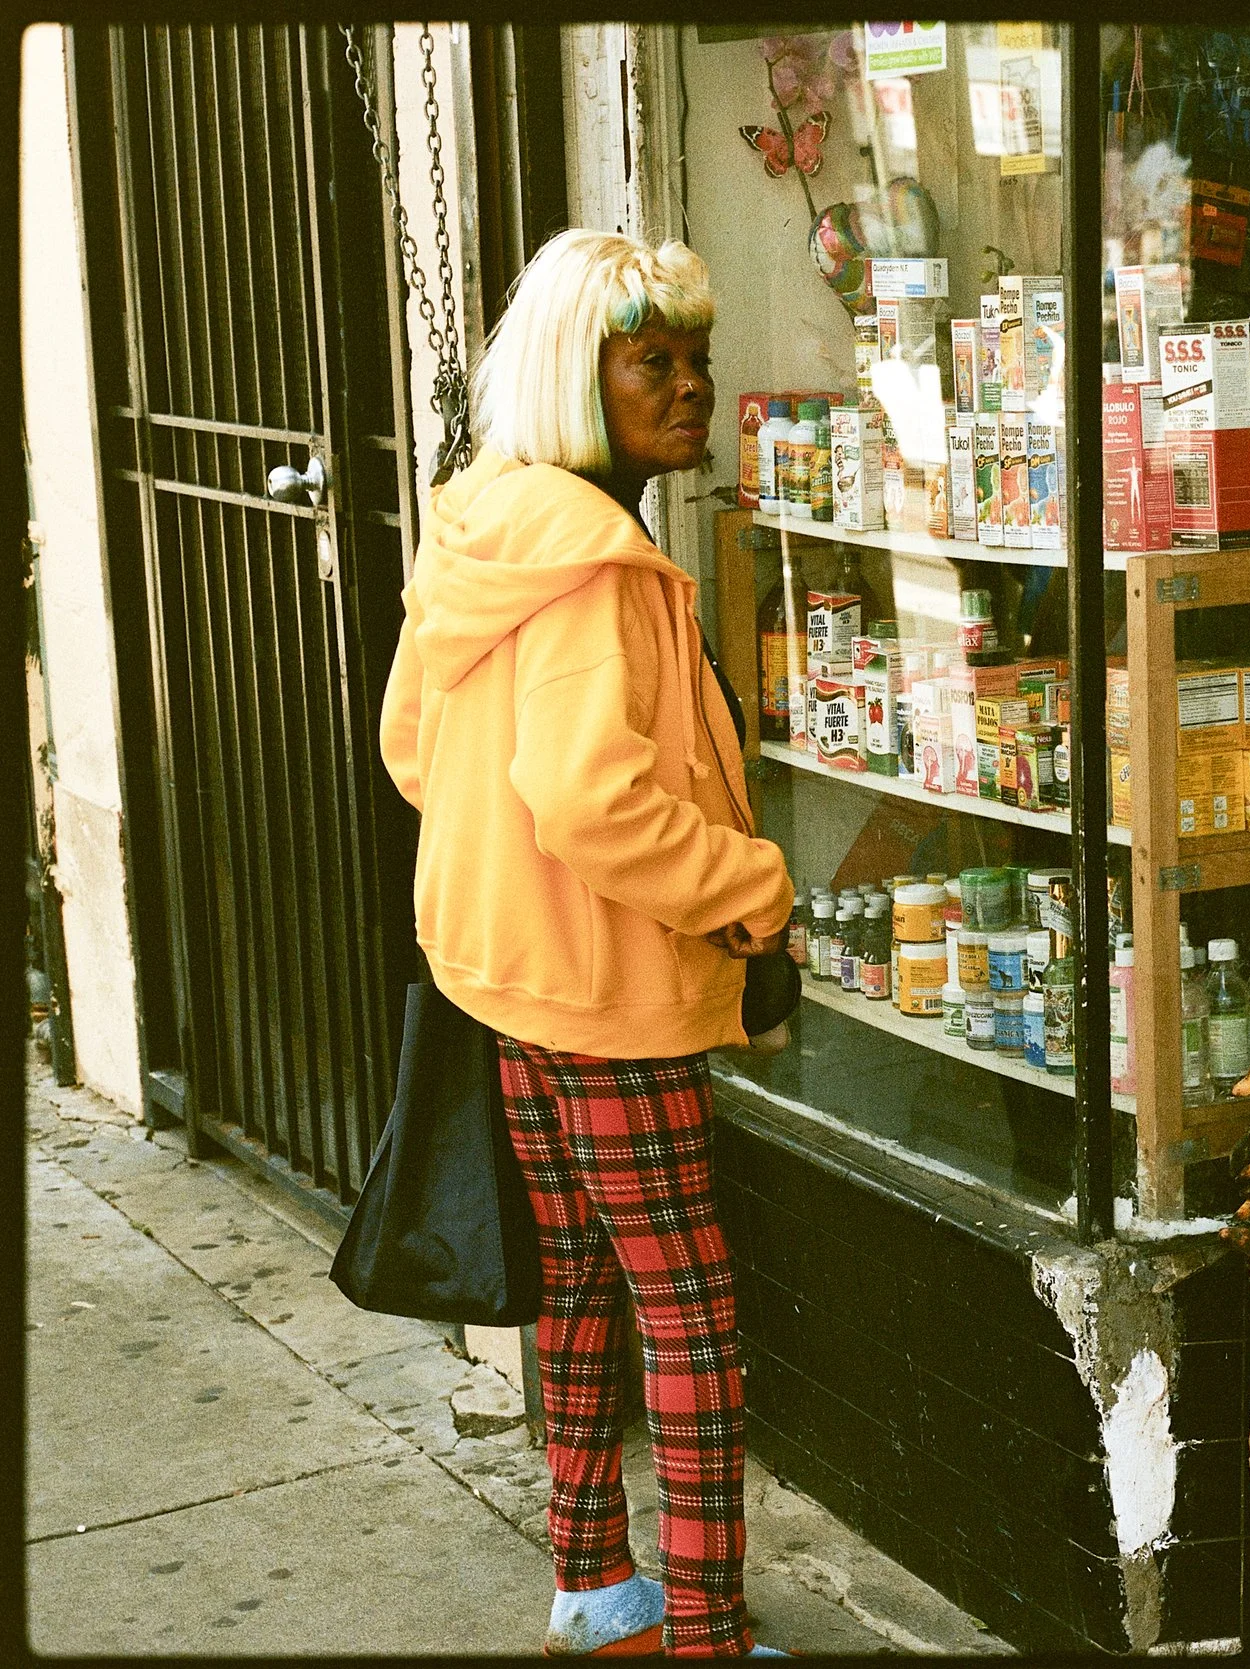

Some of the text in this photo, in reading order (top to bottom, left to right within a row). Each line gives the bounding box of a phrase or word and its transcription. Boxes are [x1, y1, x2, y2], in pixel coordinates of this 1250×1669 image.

[1036, 300, 1057, 311] Rompe
[1173, 364, 1198, 373] TONIC
[1107, 415, 1128, 425] ROJO
[975, 422, 996, 437] Rompe
[1001, 423, 1025, 438] Rompe
[1027, 422, 1052, 437] Rompe
[950, 435, 971, 451] Tukol
[975, 436, 995, 451] Pecho
[1001, 438, 1022, 451] Pecho
[1028, 436, 1050, 450] Pecho
[810, 614, 826, 627] VITAL
[808, 626, 828, 639] FUERTE
[813, 639, 825, 652] H3
[826, 702, 846, 716] VITAL
[979, 704, 995, 717] MATA
[824, 715, 849, 729] FUERTE
[977, 715, 999, 728] PIOJOS
[830, 729, 844, 743] H3
